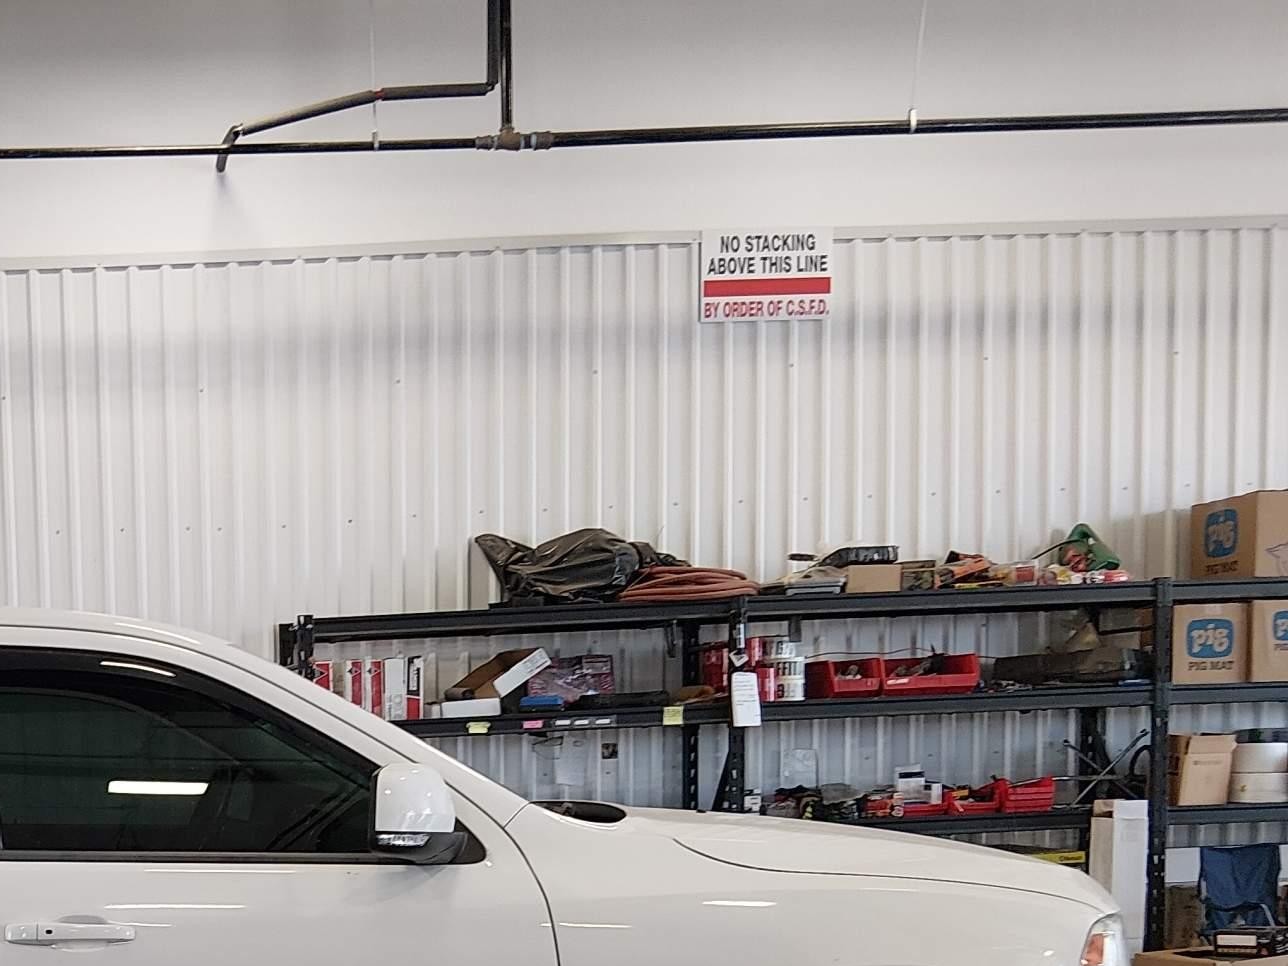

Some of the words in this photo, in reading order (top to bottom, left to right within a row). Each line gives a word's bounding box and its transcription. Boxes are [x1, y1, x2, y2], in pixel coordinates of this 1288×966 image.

[720, 235, 740, 253] NO
[744, 234, 816, 252] STACKING
[707, 256, 755, 275] ABOVE
[760, 255, 792, 274] THIS
[796, 254, 828, 272] LINE
[704, 302, 719, 318] BY
[723, 301, 763, 317] ORDER
[767, 300, 783, 316] OF
[786, 299, 829, 316] C.S.F.D.
